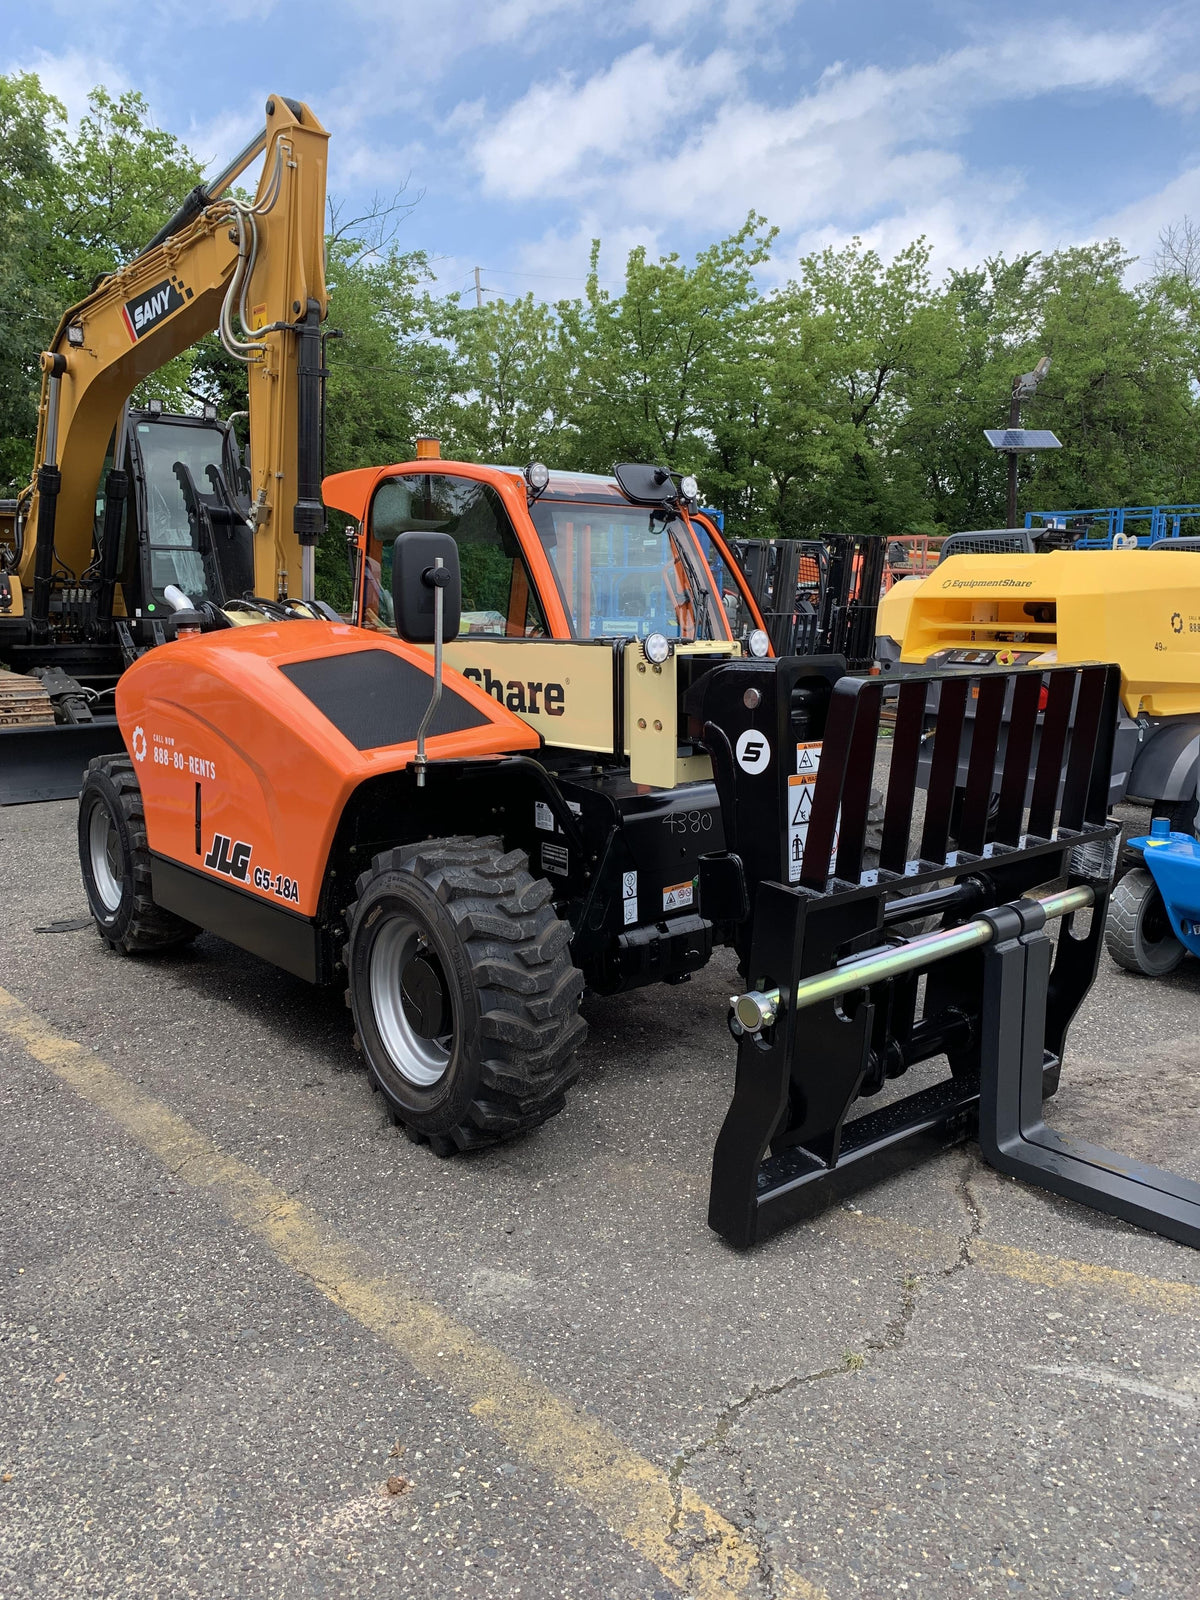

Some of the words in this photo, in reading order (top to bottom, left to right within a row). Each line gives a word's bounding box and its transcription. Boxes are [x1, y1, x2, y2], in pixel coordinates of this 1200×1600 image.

[134, 285, 171, 330] SANY
[952, 579, 1033, 588] EquipmentShare
[153, 746, 216, 780] 888-80-RENTS
[741, 742, 764, 763] 5
[662, 810, 713, 834] 4380
[204, 832, 253, 884] JLG
[254, 866, 299, 904] G5-18A
